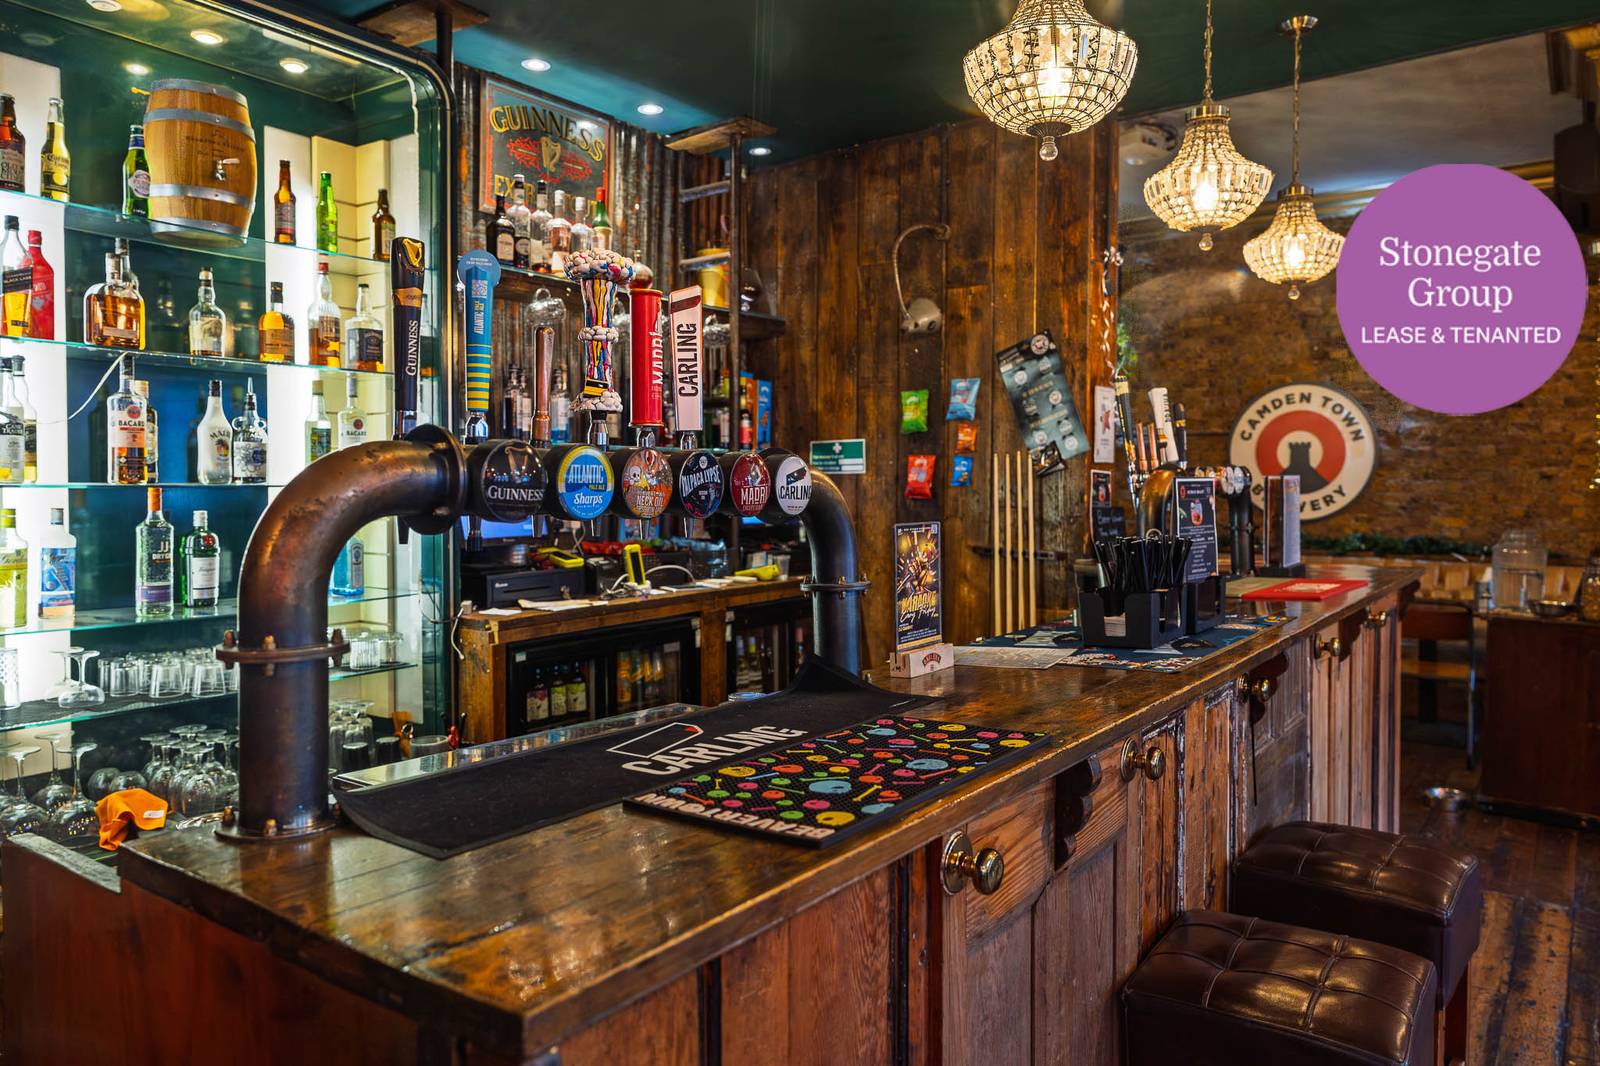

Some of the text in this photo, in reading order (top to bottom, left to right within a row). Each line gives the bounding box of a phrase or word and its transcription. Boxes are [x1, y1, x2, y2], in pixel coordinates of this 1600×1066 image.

[489, 105, 606, 161] GUINNESS
[473, 311, 485, 335] ATLANTIC
[405, 320, 419, 376] GUINNESS
[676, 323, 699, 397] CARLING
[1240, 392, 1365, 442] CAMDEN TOWN
[487, 484, 547, 502] GUINNESS
[567, 464, 605, 485] ATLANTIC
[636, 495, 653, 508] NECK
[621, 726, 809, 775] CARLING
[633, 792, 837, 838] BEAVERTOWN
